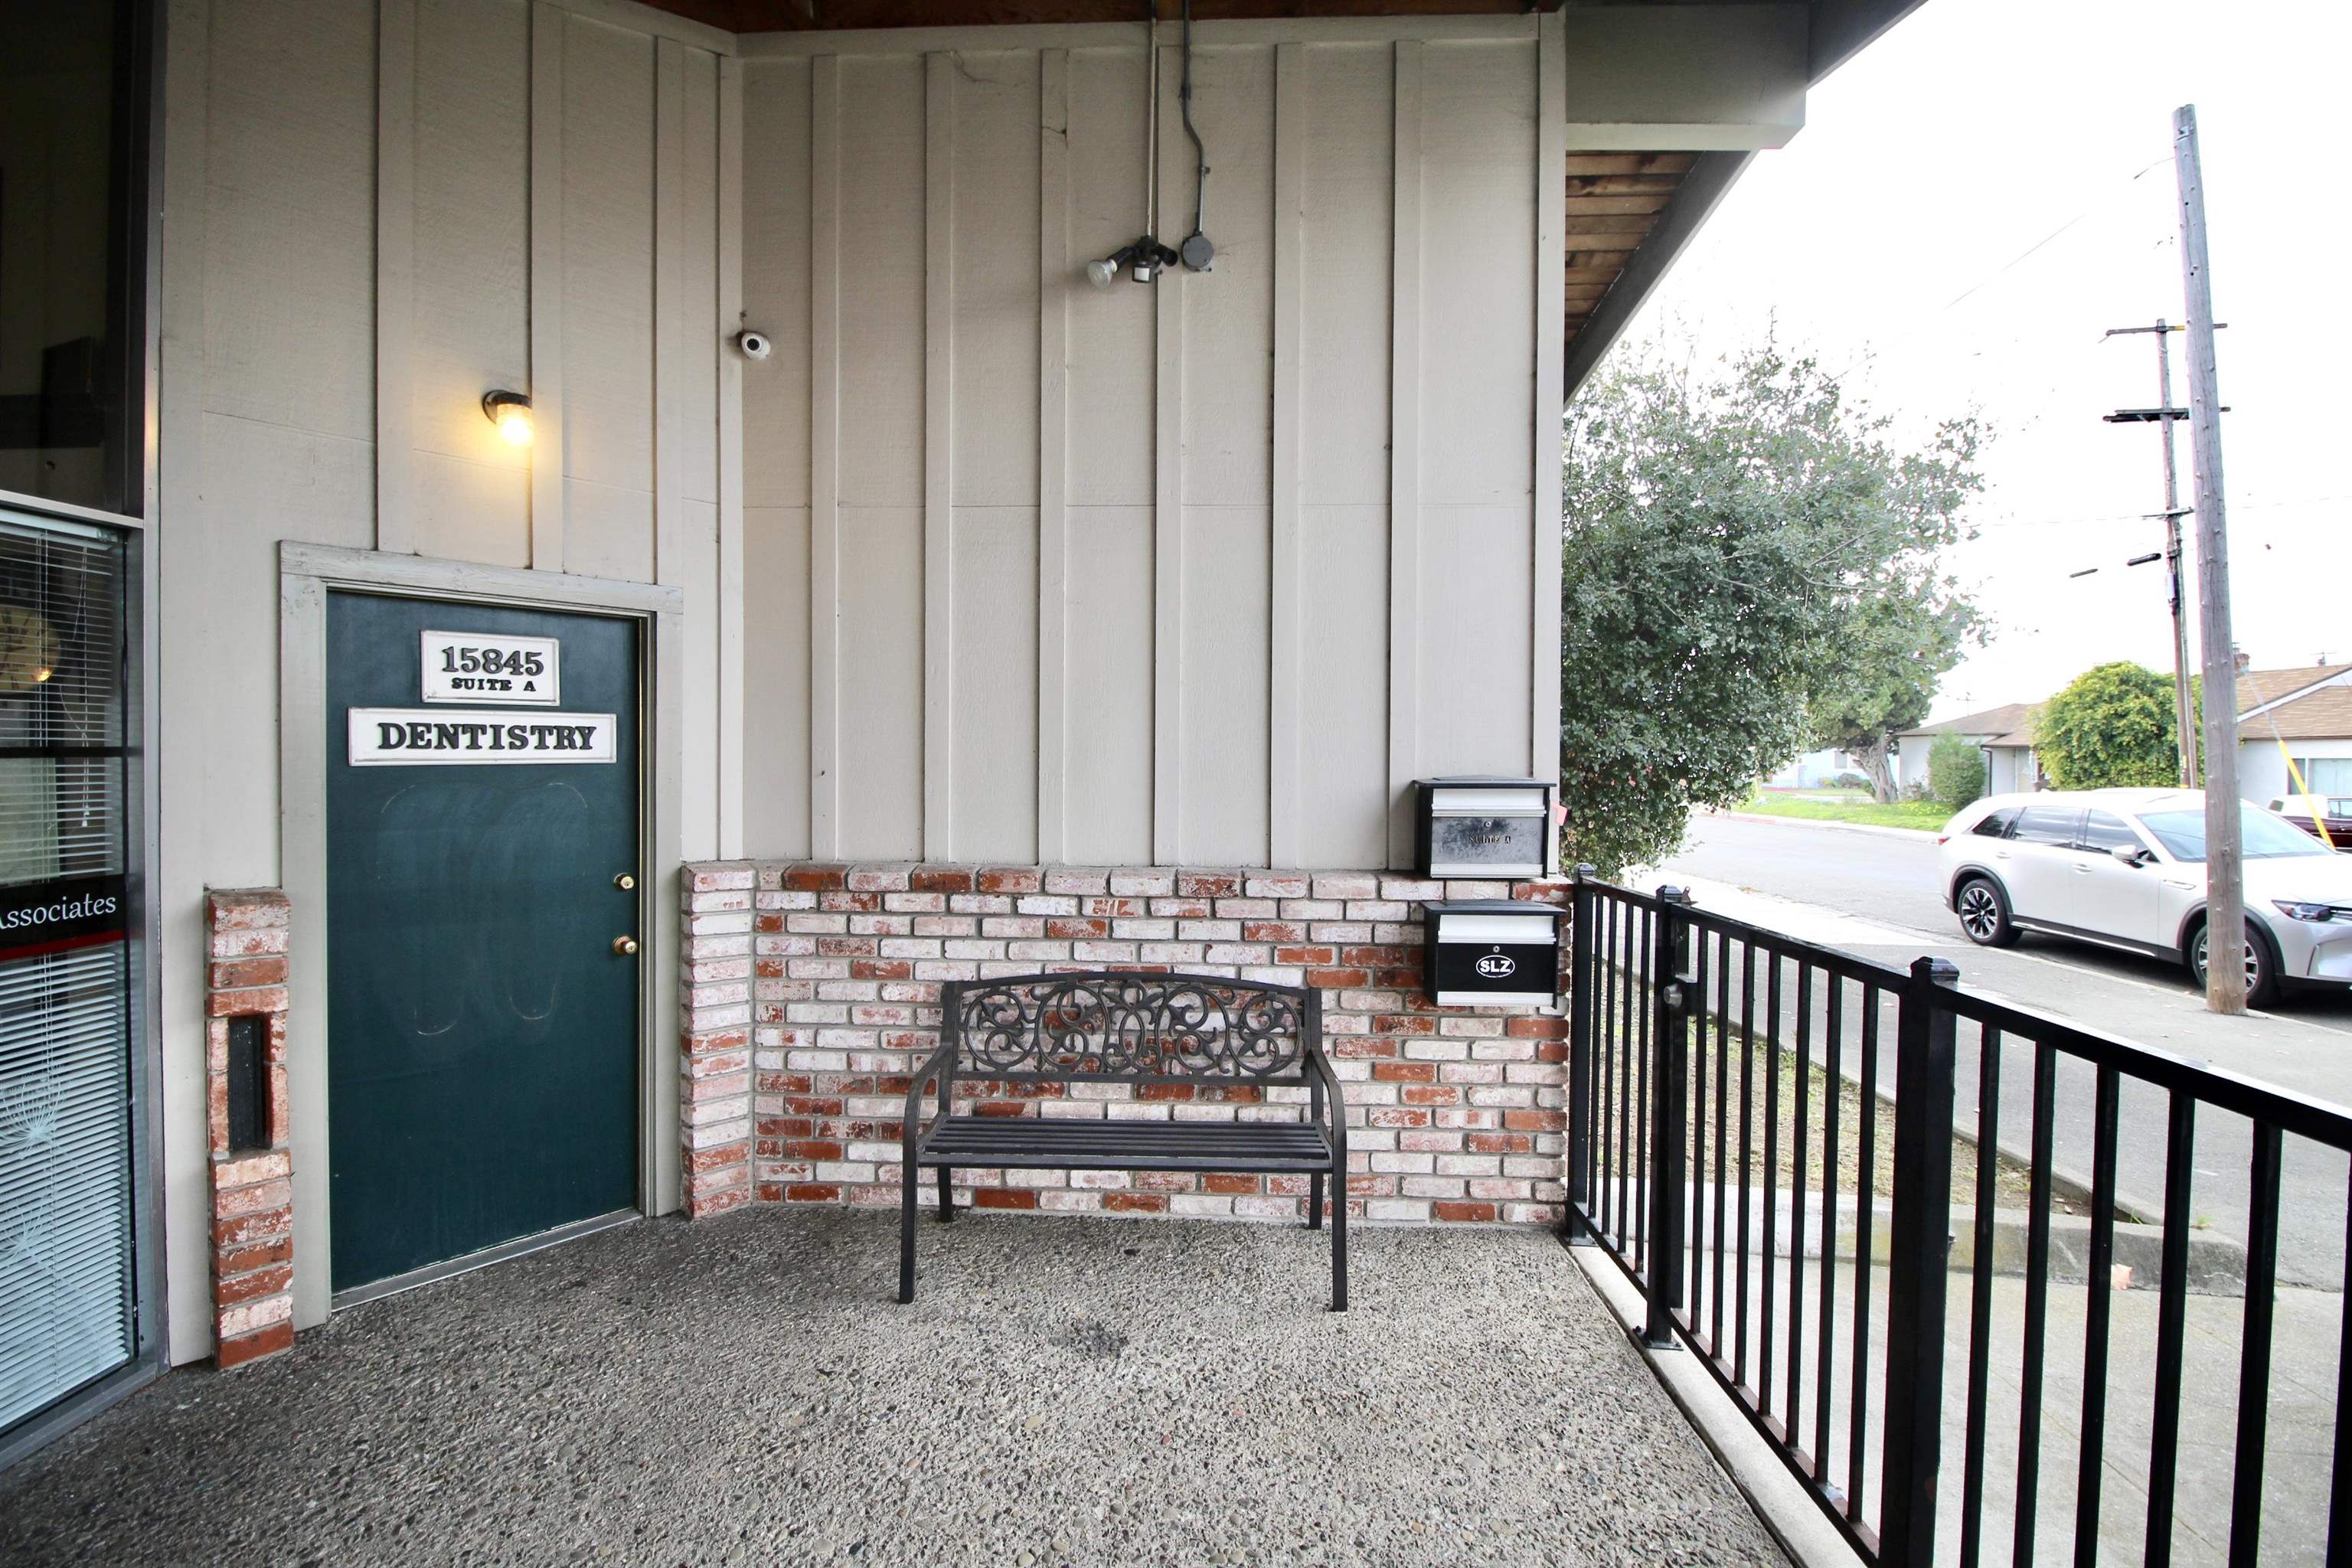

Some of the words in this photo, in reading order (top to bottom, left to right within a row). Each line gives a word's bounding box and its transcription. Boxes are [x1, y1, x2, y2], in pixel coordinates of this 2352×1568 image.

[442, 646, 544, 676] 15845
[451, 677, 512, 691] SUITE
[523, 680, 537, 692] A
[377, 722, 597, 750] DENTISTRY
[1469, 835, 1500, 844] SUITE
[1479, 960, 1511, 972] SLZ
